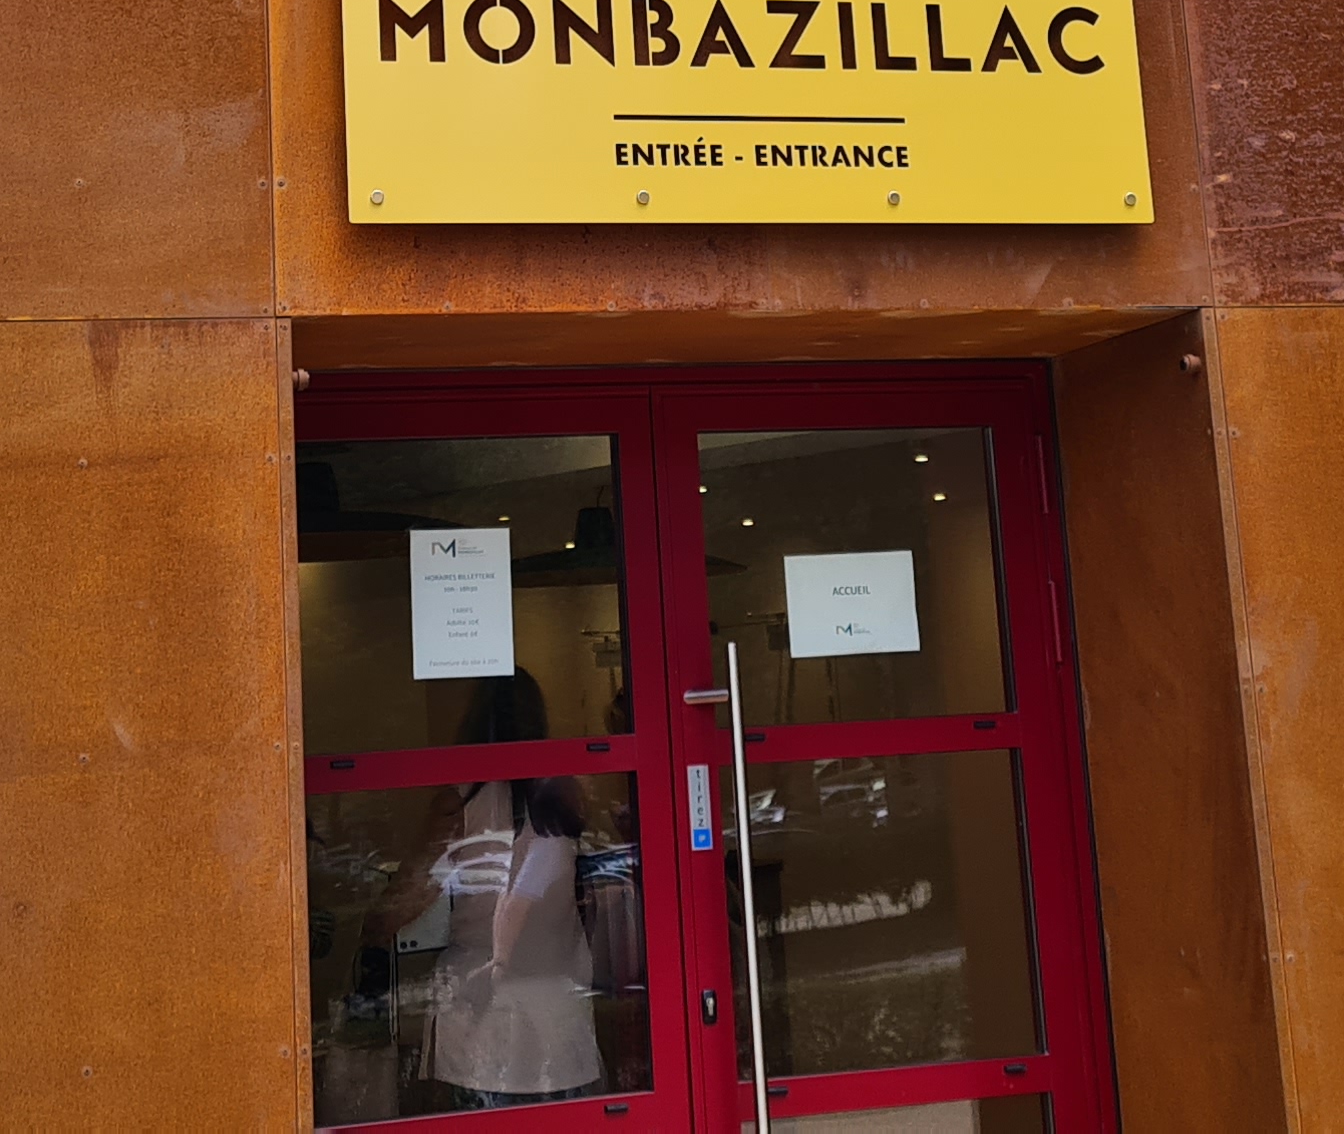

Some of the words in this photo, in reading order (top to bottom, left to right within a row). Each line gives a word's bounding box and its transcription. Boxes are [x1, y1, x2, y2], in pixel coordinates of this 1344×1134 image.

[615, 137, 724, 167] ENTRÉE
[754, 144, 909, 168] ENTRANCE
[832, 585, 872, 597] ACCUEIL
[695, 768, 705, 828] tirez
